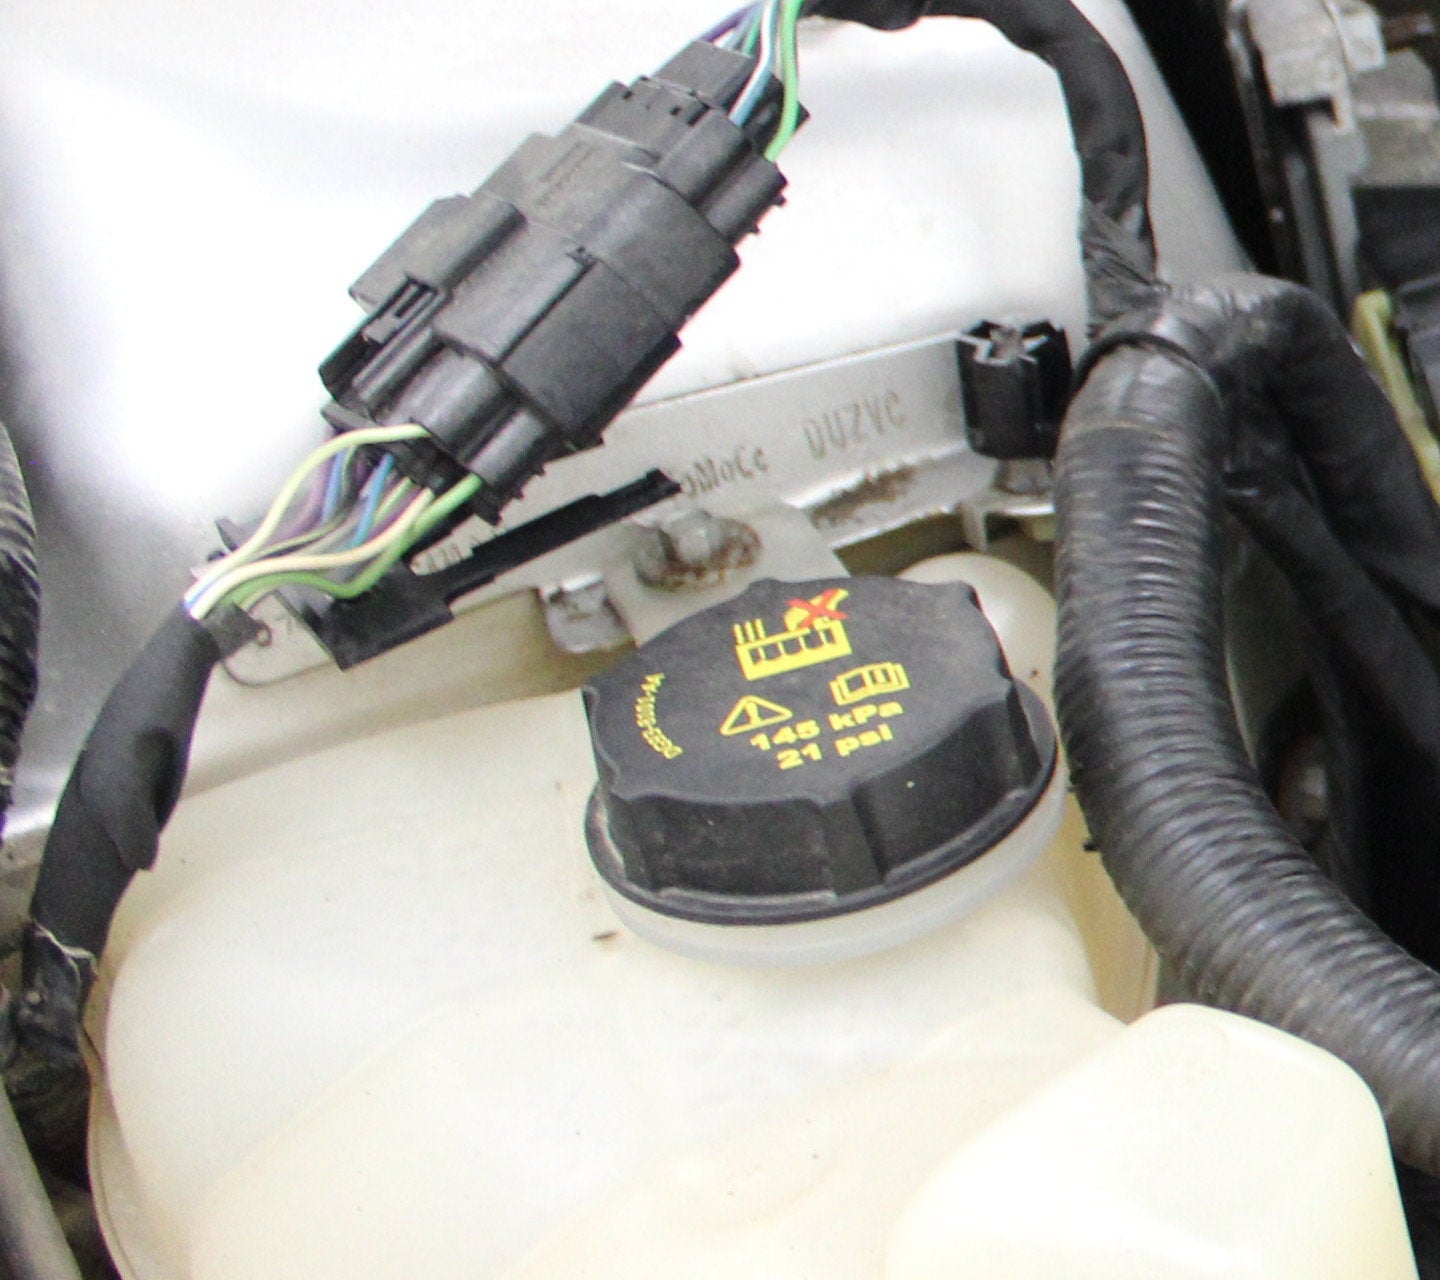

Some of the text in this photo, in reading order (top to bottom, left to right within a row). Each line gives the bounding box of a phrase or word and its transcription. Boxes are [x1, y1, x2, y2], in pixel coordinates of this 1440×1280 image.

[750, 700, 904, 751] 145 kPa
[776, 723, 894, 771] 21 psi
